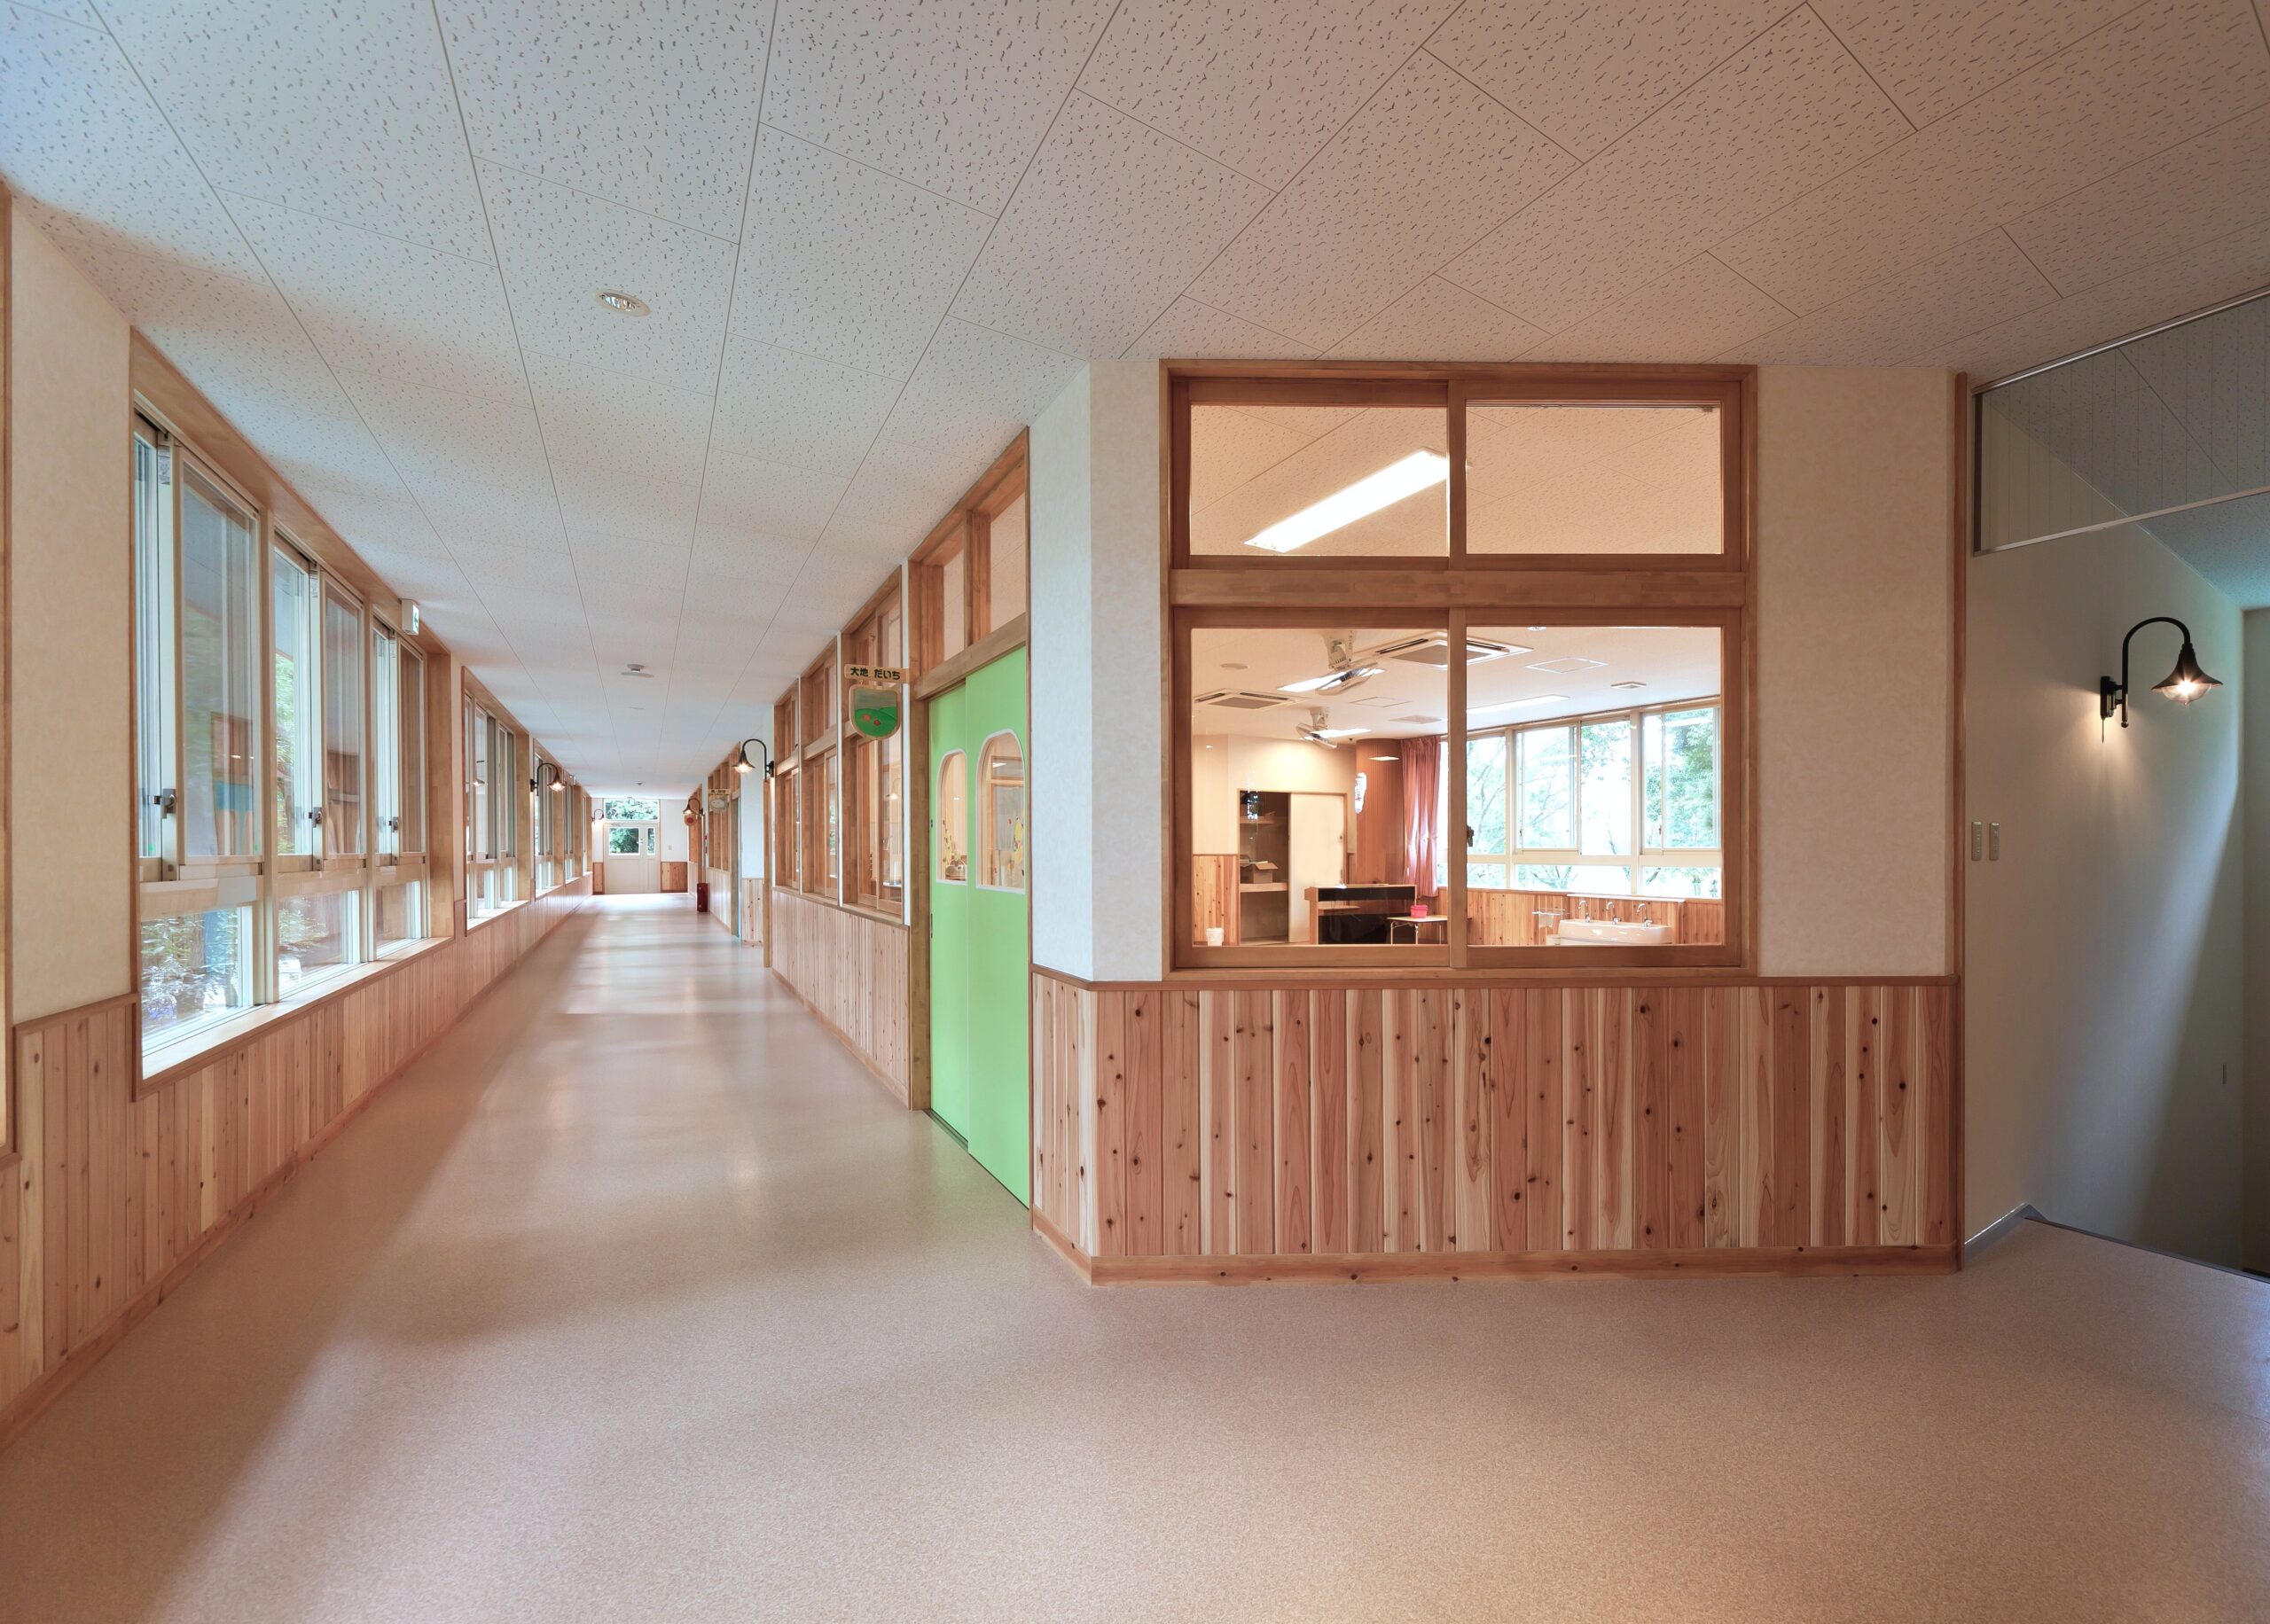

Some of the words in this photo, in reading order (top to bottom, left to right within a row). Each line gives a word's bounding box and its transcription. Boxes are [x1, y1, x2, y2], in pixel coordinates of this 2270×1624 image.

[850, 667, 868, 677] 大地
[873, 668, 900, 680] だいち
